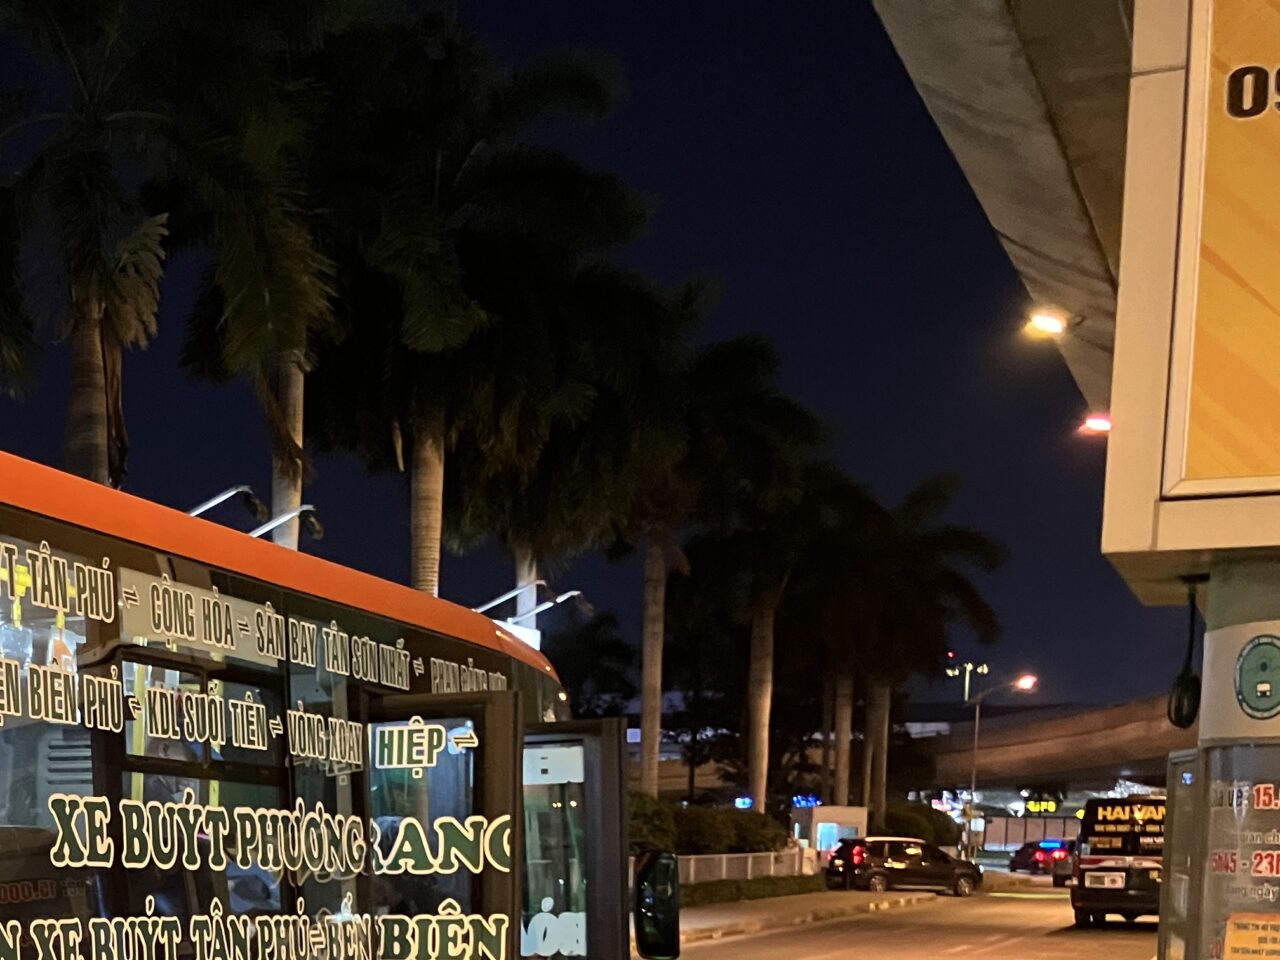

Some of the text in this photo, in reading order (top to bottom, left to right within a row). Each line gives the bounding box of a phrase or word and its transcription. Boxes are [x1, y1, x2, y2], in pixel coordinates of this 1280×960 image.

[1226, 66, 1280, 118] 0
[26, 541, 69, 612] TÂN
[73, 557, 114, 622] PHÚ
[150, 574, 197, 646] CỘNG
[200, 585, 236, 650] HÒA
[288, 617, 317, 668] BAY
[322, 620, 350, 676] TÂN
[28, 657, 79, 725] BIÊN
[146, 688, 180, 739] KDL
[229, 691, 268, 750] TIÊN
[328, 717, 363, 764] XOAY
[375, 715, 447, 778] HIỆP
[48, 787, 366, 873] XE BUÝT PHƯƠNG
[1097, 806, 1130, 820] HAI
